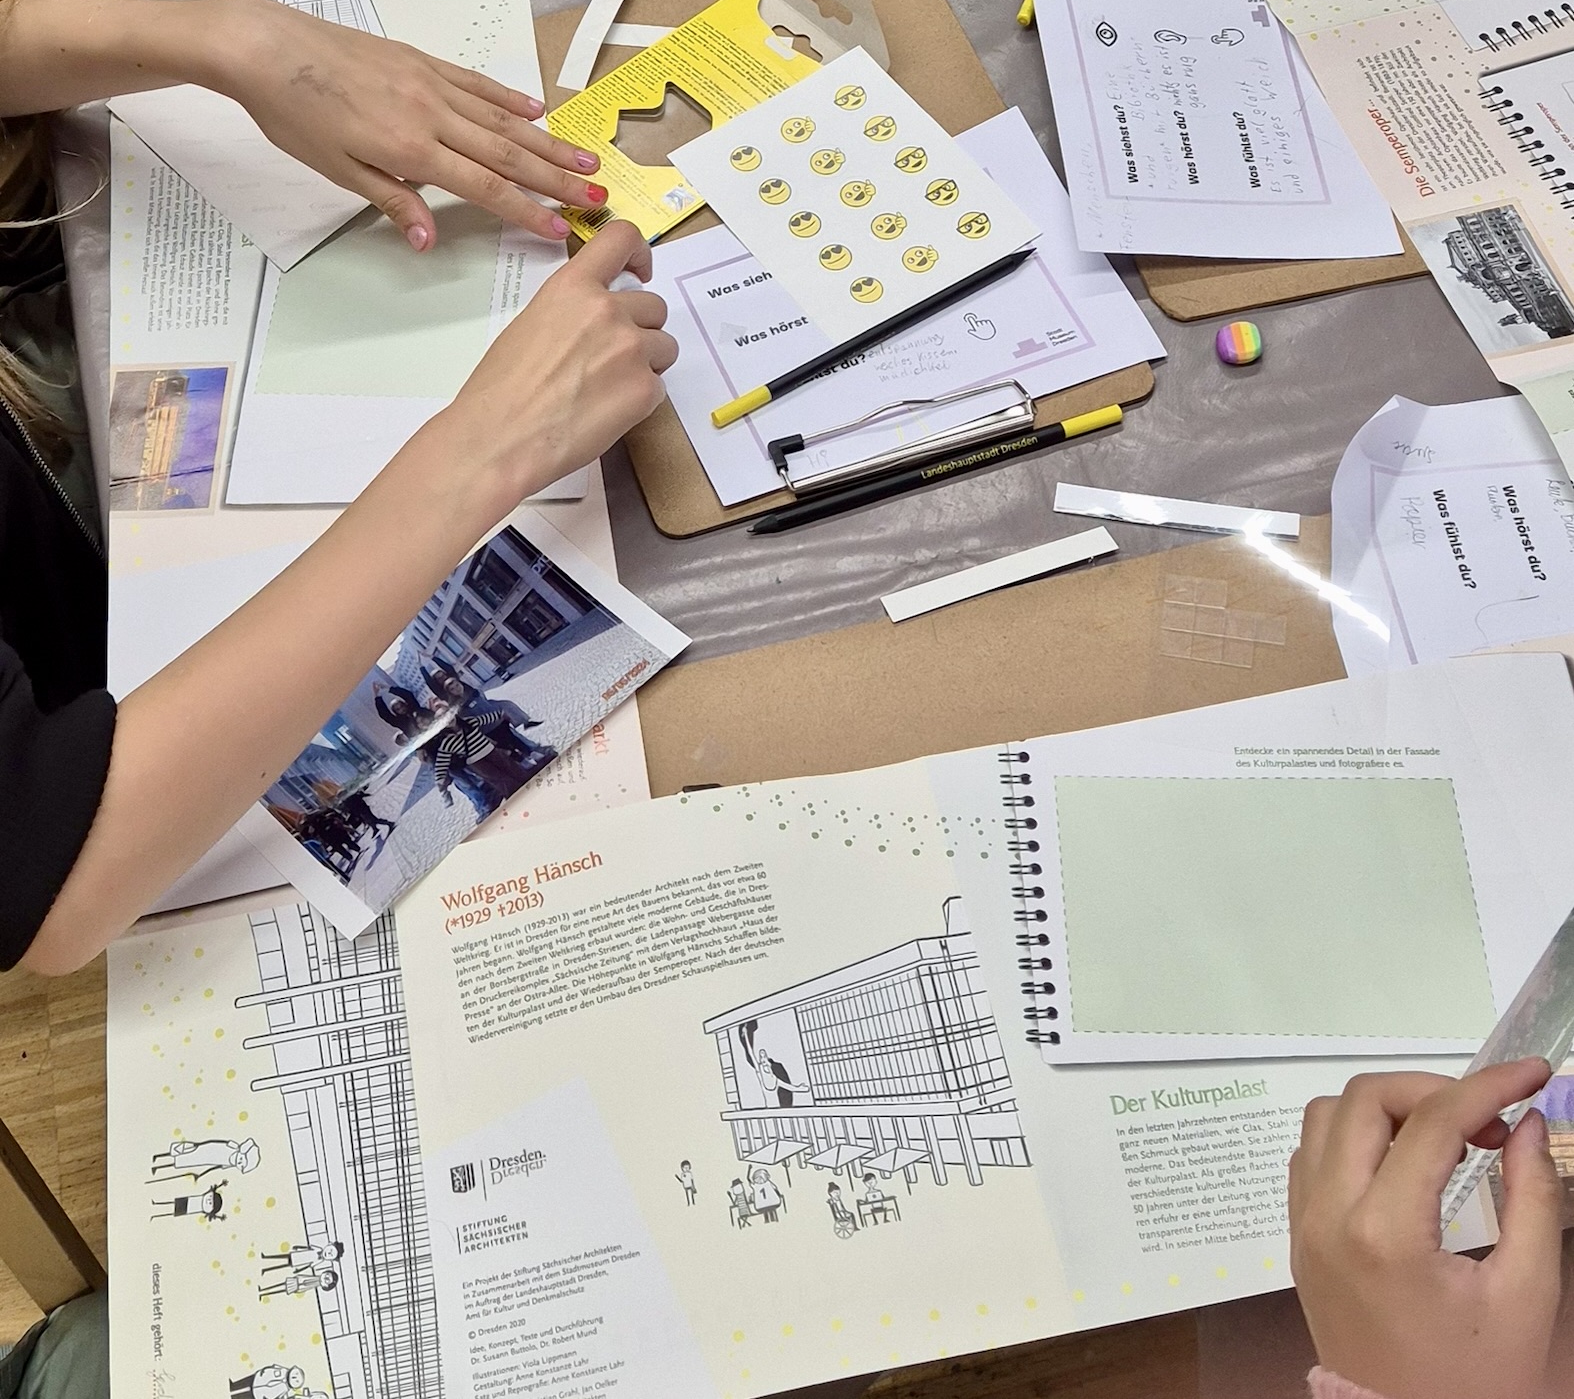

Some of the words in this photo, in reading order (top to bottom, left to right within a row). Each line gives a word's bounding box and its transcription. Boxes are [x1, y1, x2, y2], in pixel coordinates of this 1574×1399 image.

[1112, 104, 1127, 123] du?
[1172, 110, 1187, 129] du?
[1232, 111, 1247, 130] du?
[1118, 125, 1133, 157] siehst
[1179, 131, 1194, 159] hörst
[1238, 132, 1255, 162] fühlst
[1126, 159, 1138, 183] Was
[1186, 161, 1199, 184] Was
[1248, 165, 1261, 188] Was
[1415, 175, 1436, 197] Die
[706, 283, 740, 298] Was
[733, 331, 767, 347] Was
[768, 316, 809, 335] hörst
[839, 353, 867, 371] du?
[919, 445, 1002, 482] Landeshauptstadt
[1000, 434, 1040, 456] Dresden
[1432, 488, 1449, 518] Was
[1442, 521, 1465, 560] fühlst
[1457, 563, 1477, 589] du?
[1501, 485, 1519, 513] Was
[1512, 516, 1535, 552] hörst
[1527, 555, 1547, 581] du?
[1233, 746, 1274, 755] Entdecke
[1276, 747, 1290, 755] ein
[1292, 746, 1345, 757] spannendes
[1345, 746, 1374, 755] Detail
[1375, 747, 1385, 755] in
[1386, 746, 1402, 755] der
[1404, 746, 1440, 755] Fassade
[1235, 759, 1251, 767] des
[1252, 758, 1318, 769] Kulturpalastes
[1318, 759, 1336, 767] und
[439, 875, 530, 911] Wolfgang
[533, 850, 603, 884] Hänsch
[450, 938, 488, 954] Wolfgang
[489, 926, 521, 941] Hänsch
[523, 911, 570, 933] (1929-2013)
[571, 908, 586, 917] war
[588, 903, 601, 912] ein
[603, 888, 652, 907] bedeutender
[654, 877, 690, 893] Architekt
[691, 872, 711, 882] nach
[713, 868, 731, 877] dem
[732, 862, 764, 873] Zweiten
[497, 893, 545, 919] †2013)
[455, 963, 481, 976] Jahren
[482, 954, 513, 968] begann.
[515, 940, 554, 957] Wolfgang
[554, 929, 585, 945] Hänsch
[587, 919, 625, 937] gestaltete
[626, 912, 645, 923] viele
[647, 902, 682, 917] moderne
[684, 892, 722, 907] Gebäude,
[723, 889, 736, 897] die
[747, 883, 769, 893] Dres-
[1110, 1094, 1147, 1115] Der
[1151, 1078, 1268, 1110] Kulturpalast
[1115, 1128, 1125, 1136] In
[1127, 1124, 1144, 1135] den
[1145, 1122, 1175, 1132] letzten
[1176, 1115, 1228, 1131] Jahrzehnten
[1229, 1107, 1276, 1121] entstanden
[1118, 1140, 1140, 1151] ganz
[1142, 1136, 1169, 1145] neuen
[1171, 1128, 1222, 1142] Materialien,
[1223, 1125, 1240, 1135] wie
[1241, 1122, 1265, 1133] Glas,
[1266, 1118, 1289, 1130] Stahl
[488, 1148, 546, 1171] Dresden.
[462, 1214, 507, 1233] STIFTUNG
[462, 1220, 526, 1243] SÄCHSISCHER
[463, 1226, 528, 1254] ARCHITEKTEN
[151, 1262, 162, 1295] dieses
[462, 1281, 473, 1289] Ein
[474, 1273, 499, 1286] Projekt
[500, 1271, 512, 1280] der
[512, 1264, 541, 1277] Stiftung
[541, 1254, 582, 1270] Sächsischer
[583, 1244, 622, 1259] Architekten
[471, 1277, 530, 1298] Zusammenarbeit
[531, 1272, 544, 1283] mit
[544, 1270, 561, 1280] dem
[561, 1258, 610, 1276] Stadtmuseum
[610, 1250, 640, 1263] Dresden
[152, 1296, 163, 1321] Heft
[150, 1323, 164, 1361] gehört:
